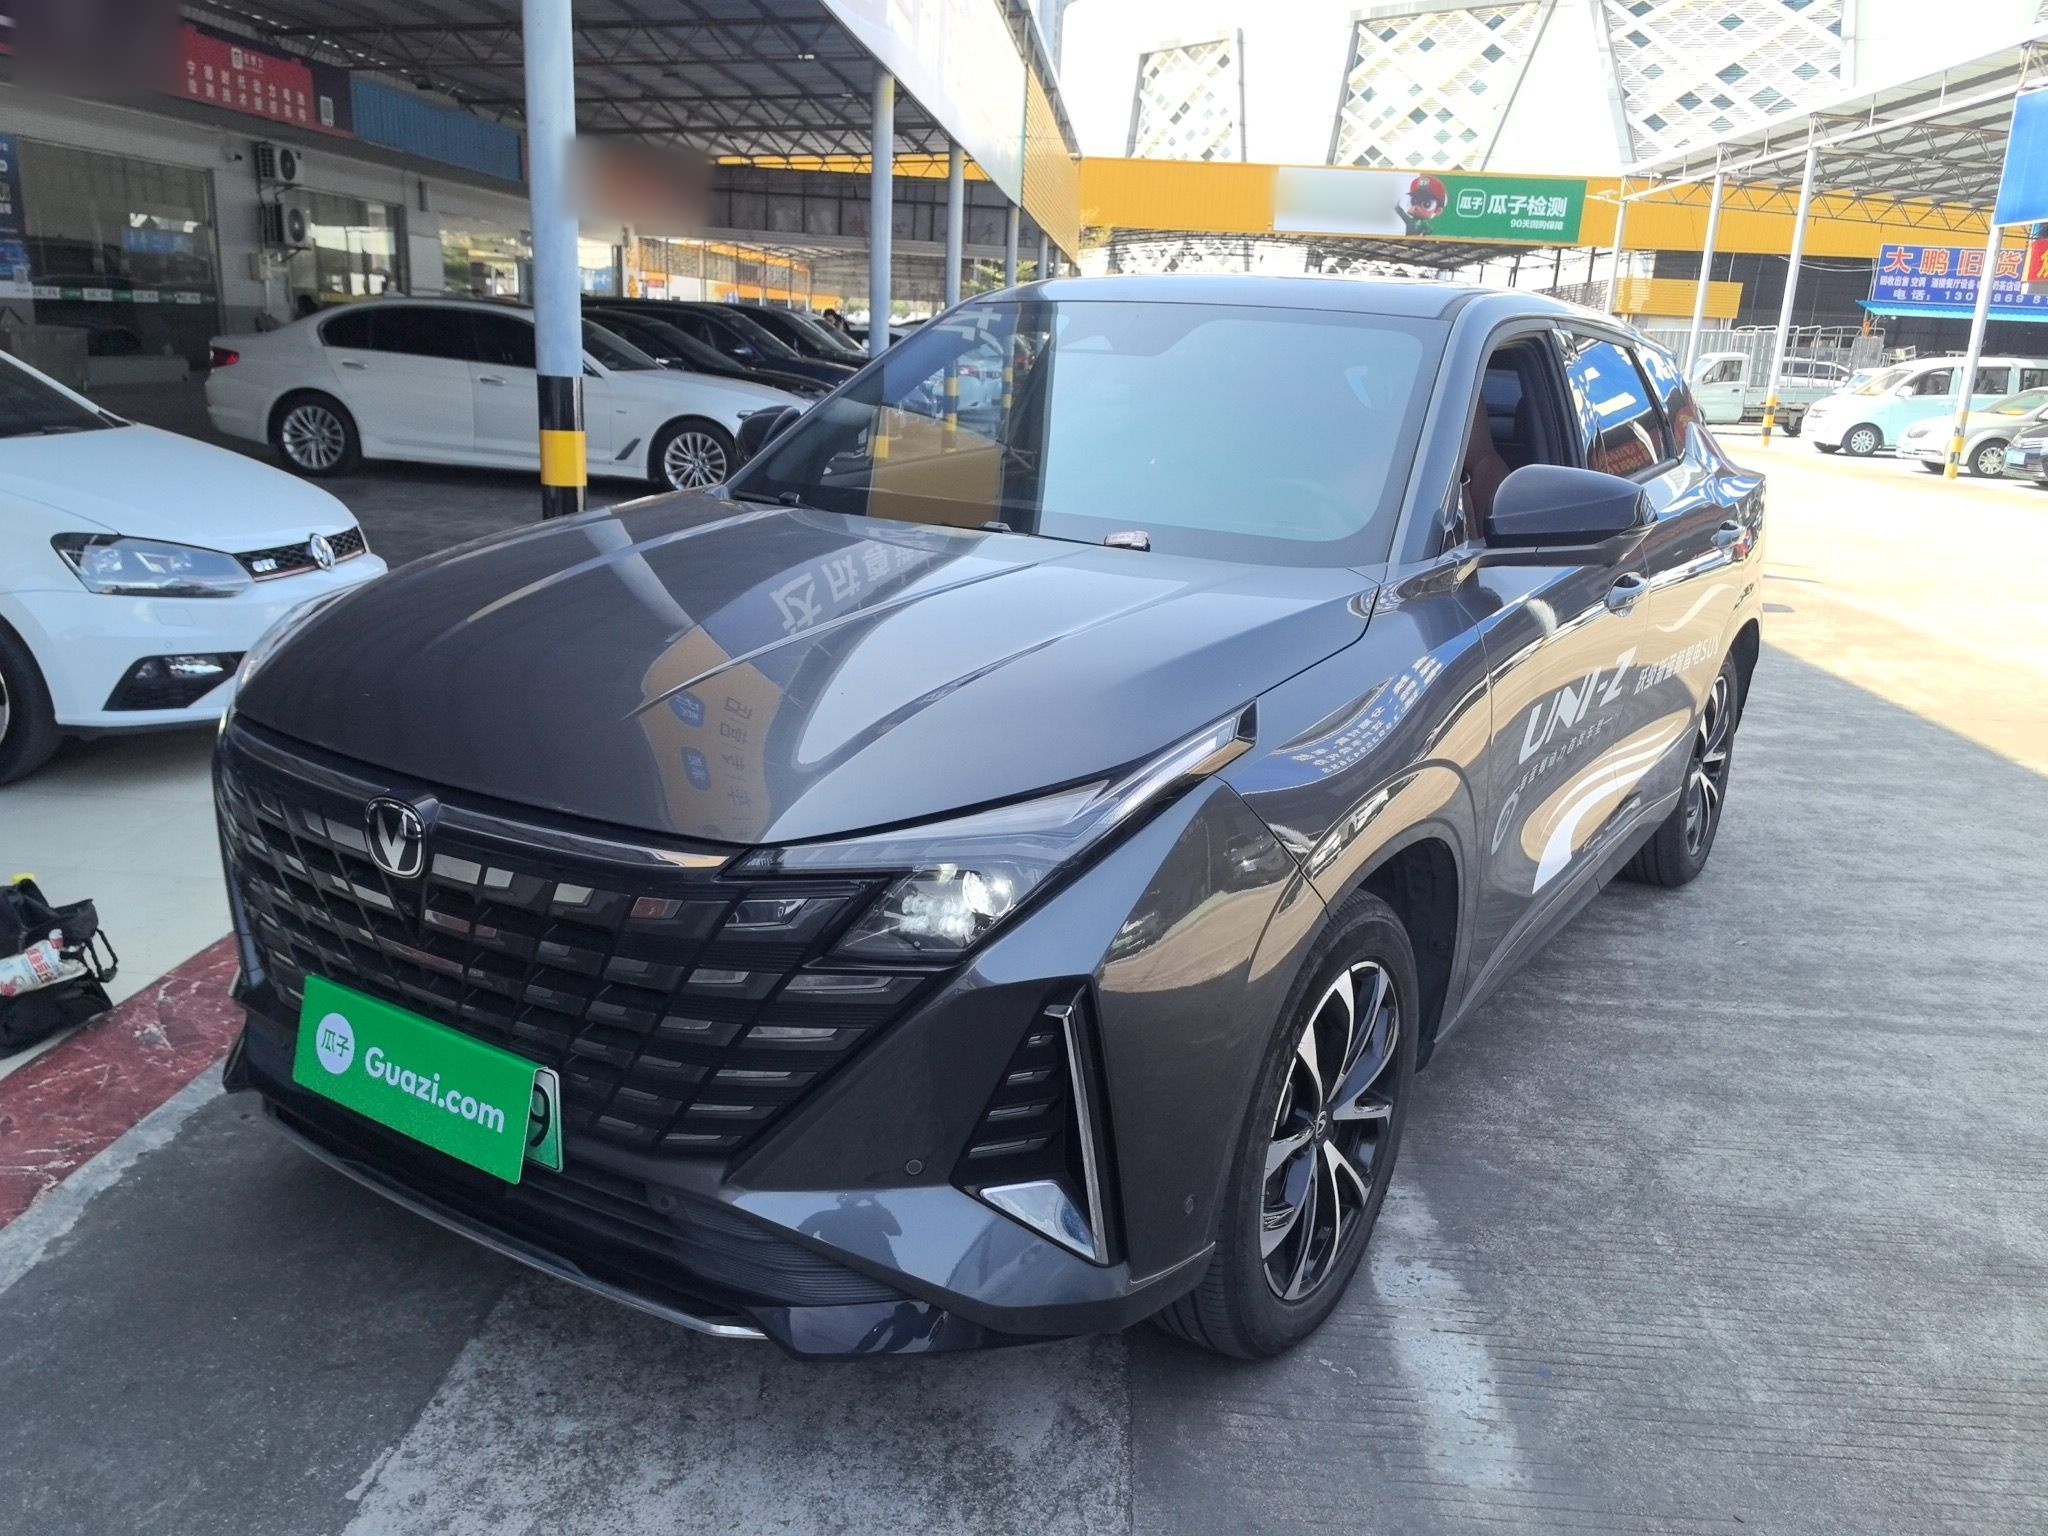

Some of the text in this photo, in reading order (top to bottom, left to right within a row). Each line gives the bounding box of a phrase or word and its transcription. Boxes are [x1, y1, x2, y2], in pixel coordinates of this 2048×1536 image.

[1459, 196, 1483, 210] 瓜子
[1487, 194, 1568, 217] 瓜子检测
[1884, 246, 2024, 279] 大鹏旧货
[1910, 276, 1926, 288] 空调
[1518, 646, 1637, 765] UNI-Z
[320, 1028, 350, 1058] 瓜子
[364, 1046, 505, 1134] Guazi.com
